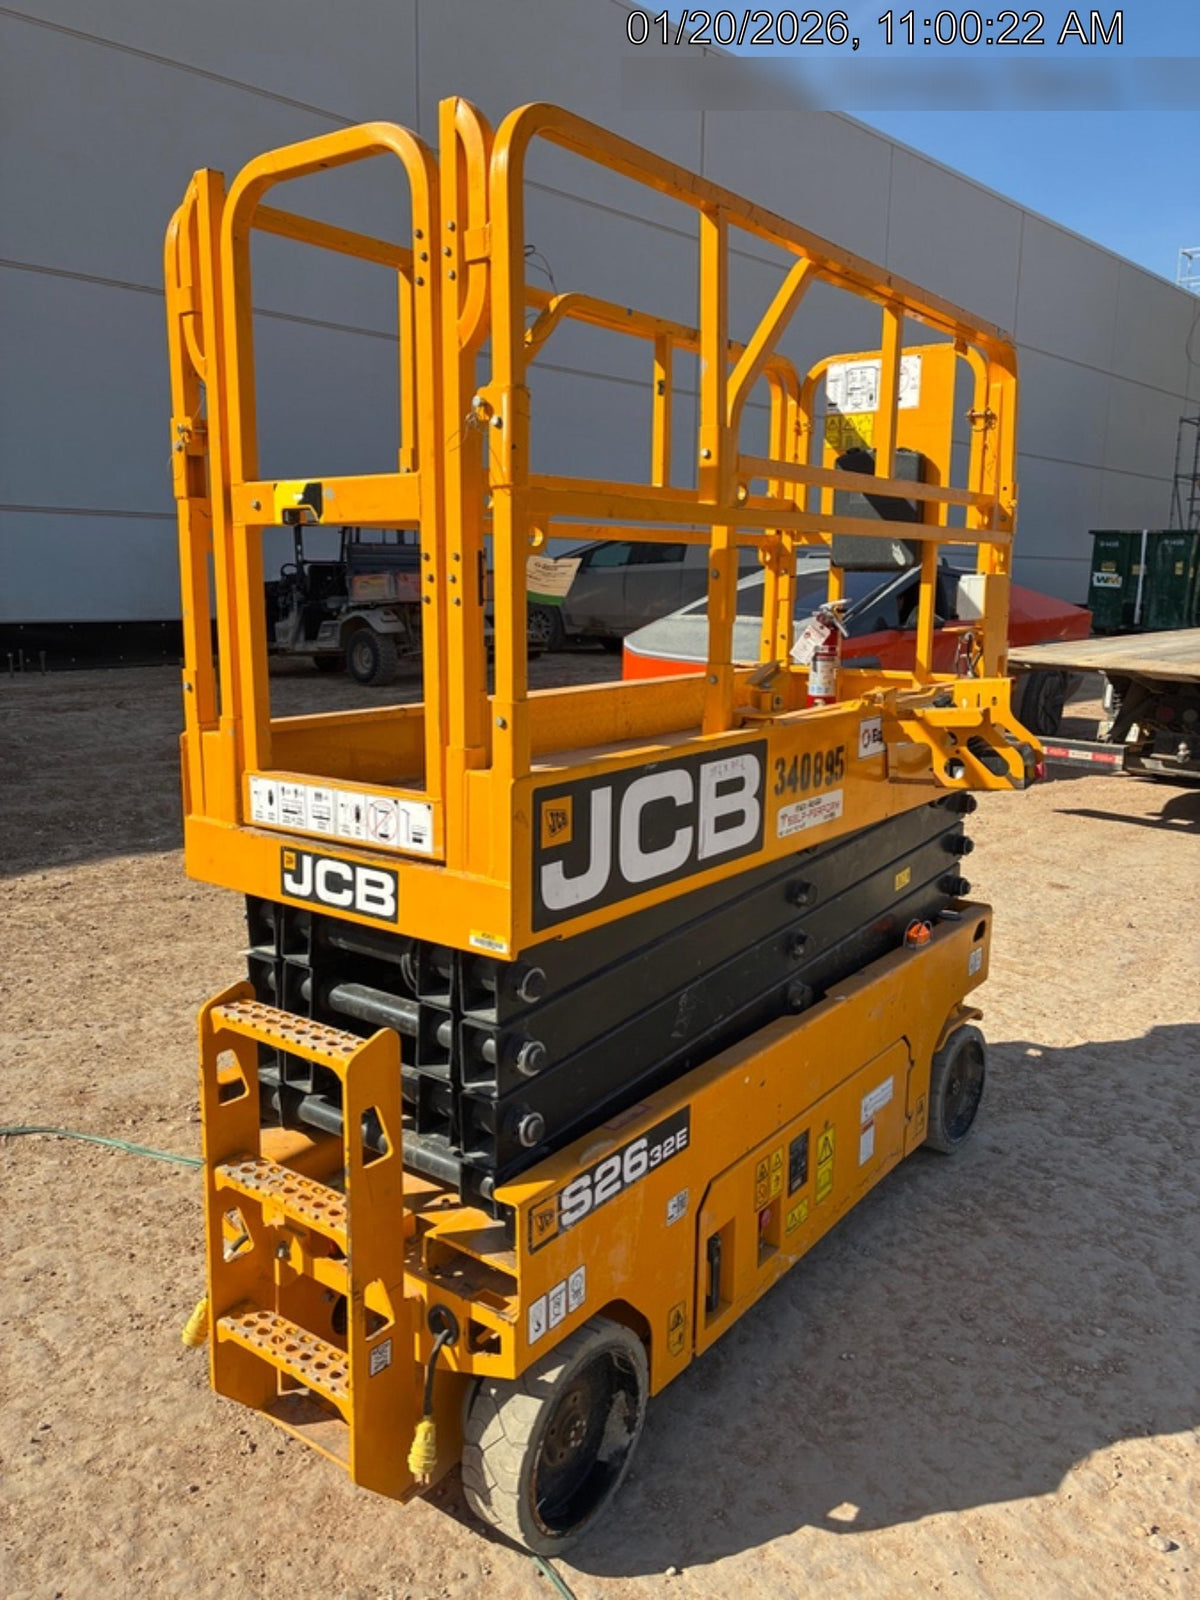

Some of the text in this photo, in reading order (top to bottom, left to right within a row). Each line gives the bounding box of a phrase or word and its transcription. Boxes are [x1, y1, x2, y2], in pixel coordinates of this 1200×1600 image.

[774, 745, 845, 796] 340895
[541, 752, 761, 911] JCB
[283, 854, 396, 917] JCB
